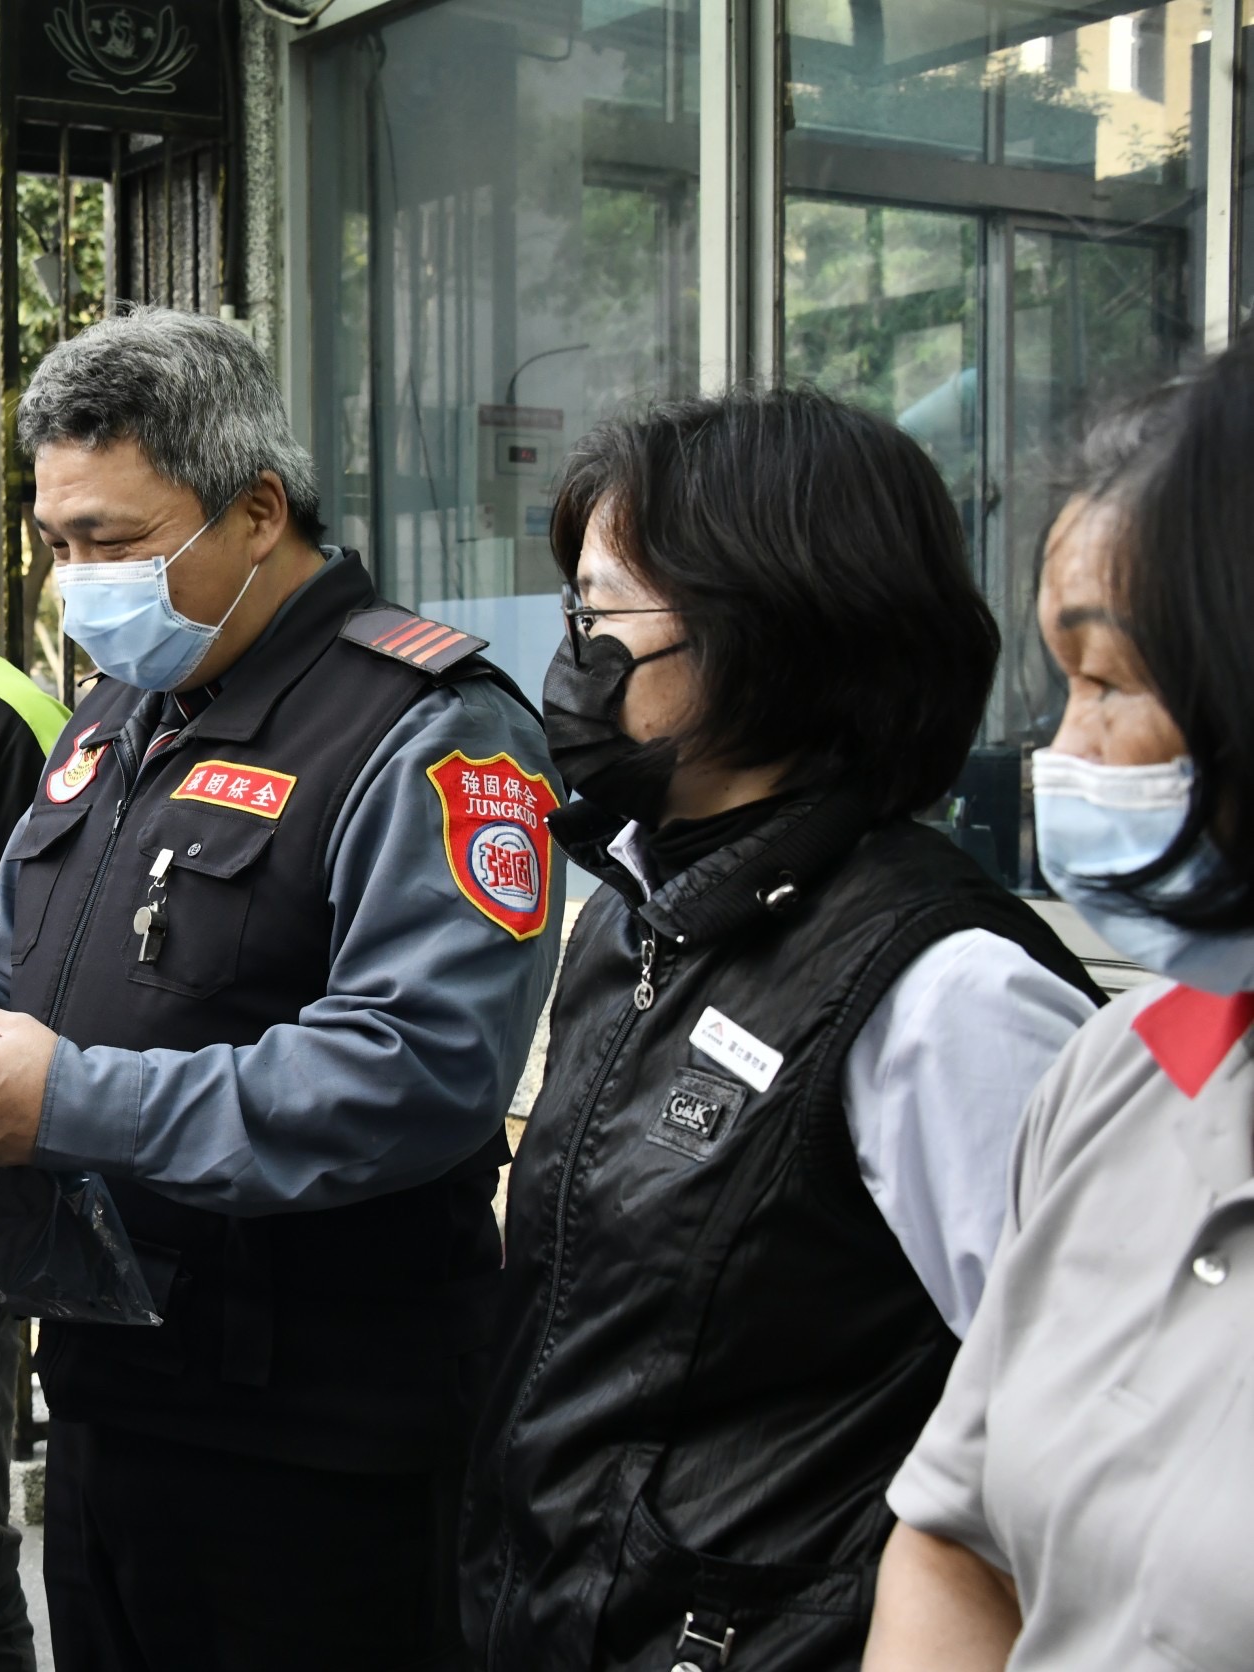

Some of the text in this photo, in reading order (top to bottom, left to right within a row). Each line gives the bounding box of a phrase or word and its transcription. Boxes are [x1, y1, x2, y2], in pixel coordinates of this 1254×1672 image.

[461, 770, 538, 809] 強固保全
[465, 797, 538, 829] JUNGKUO
[670, 1097, 710, 1125] G&K
